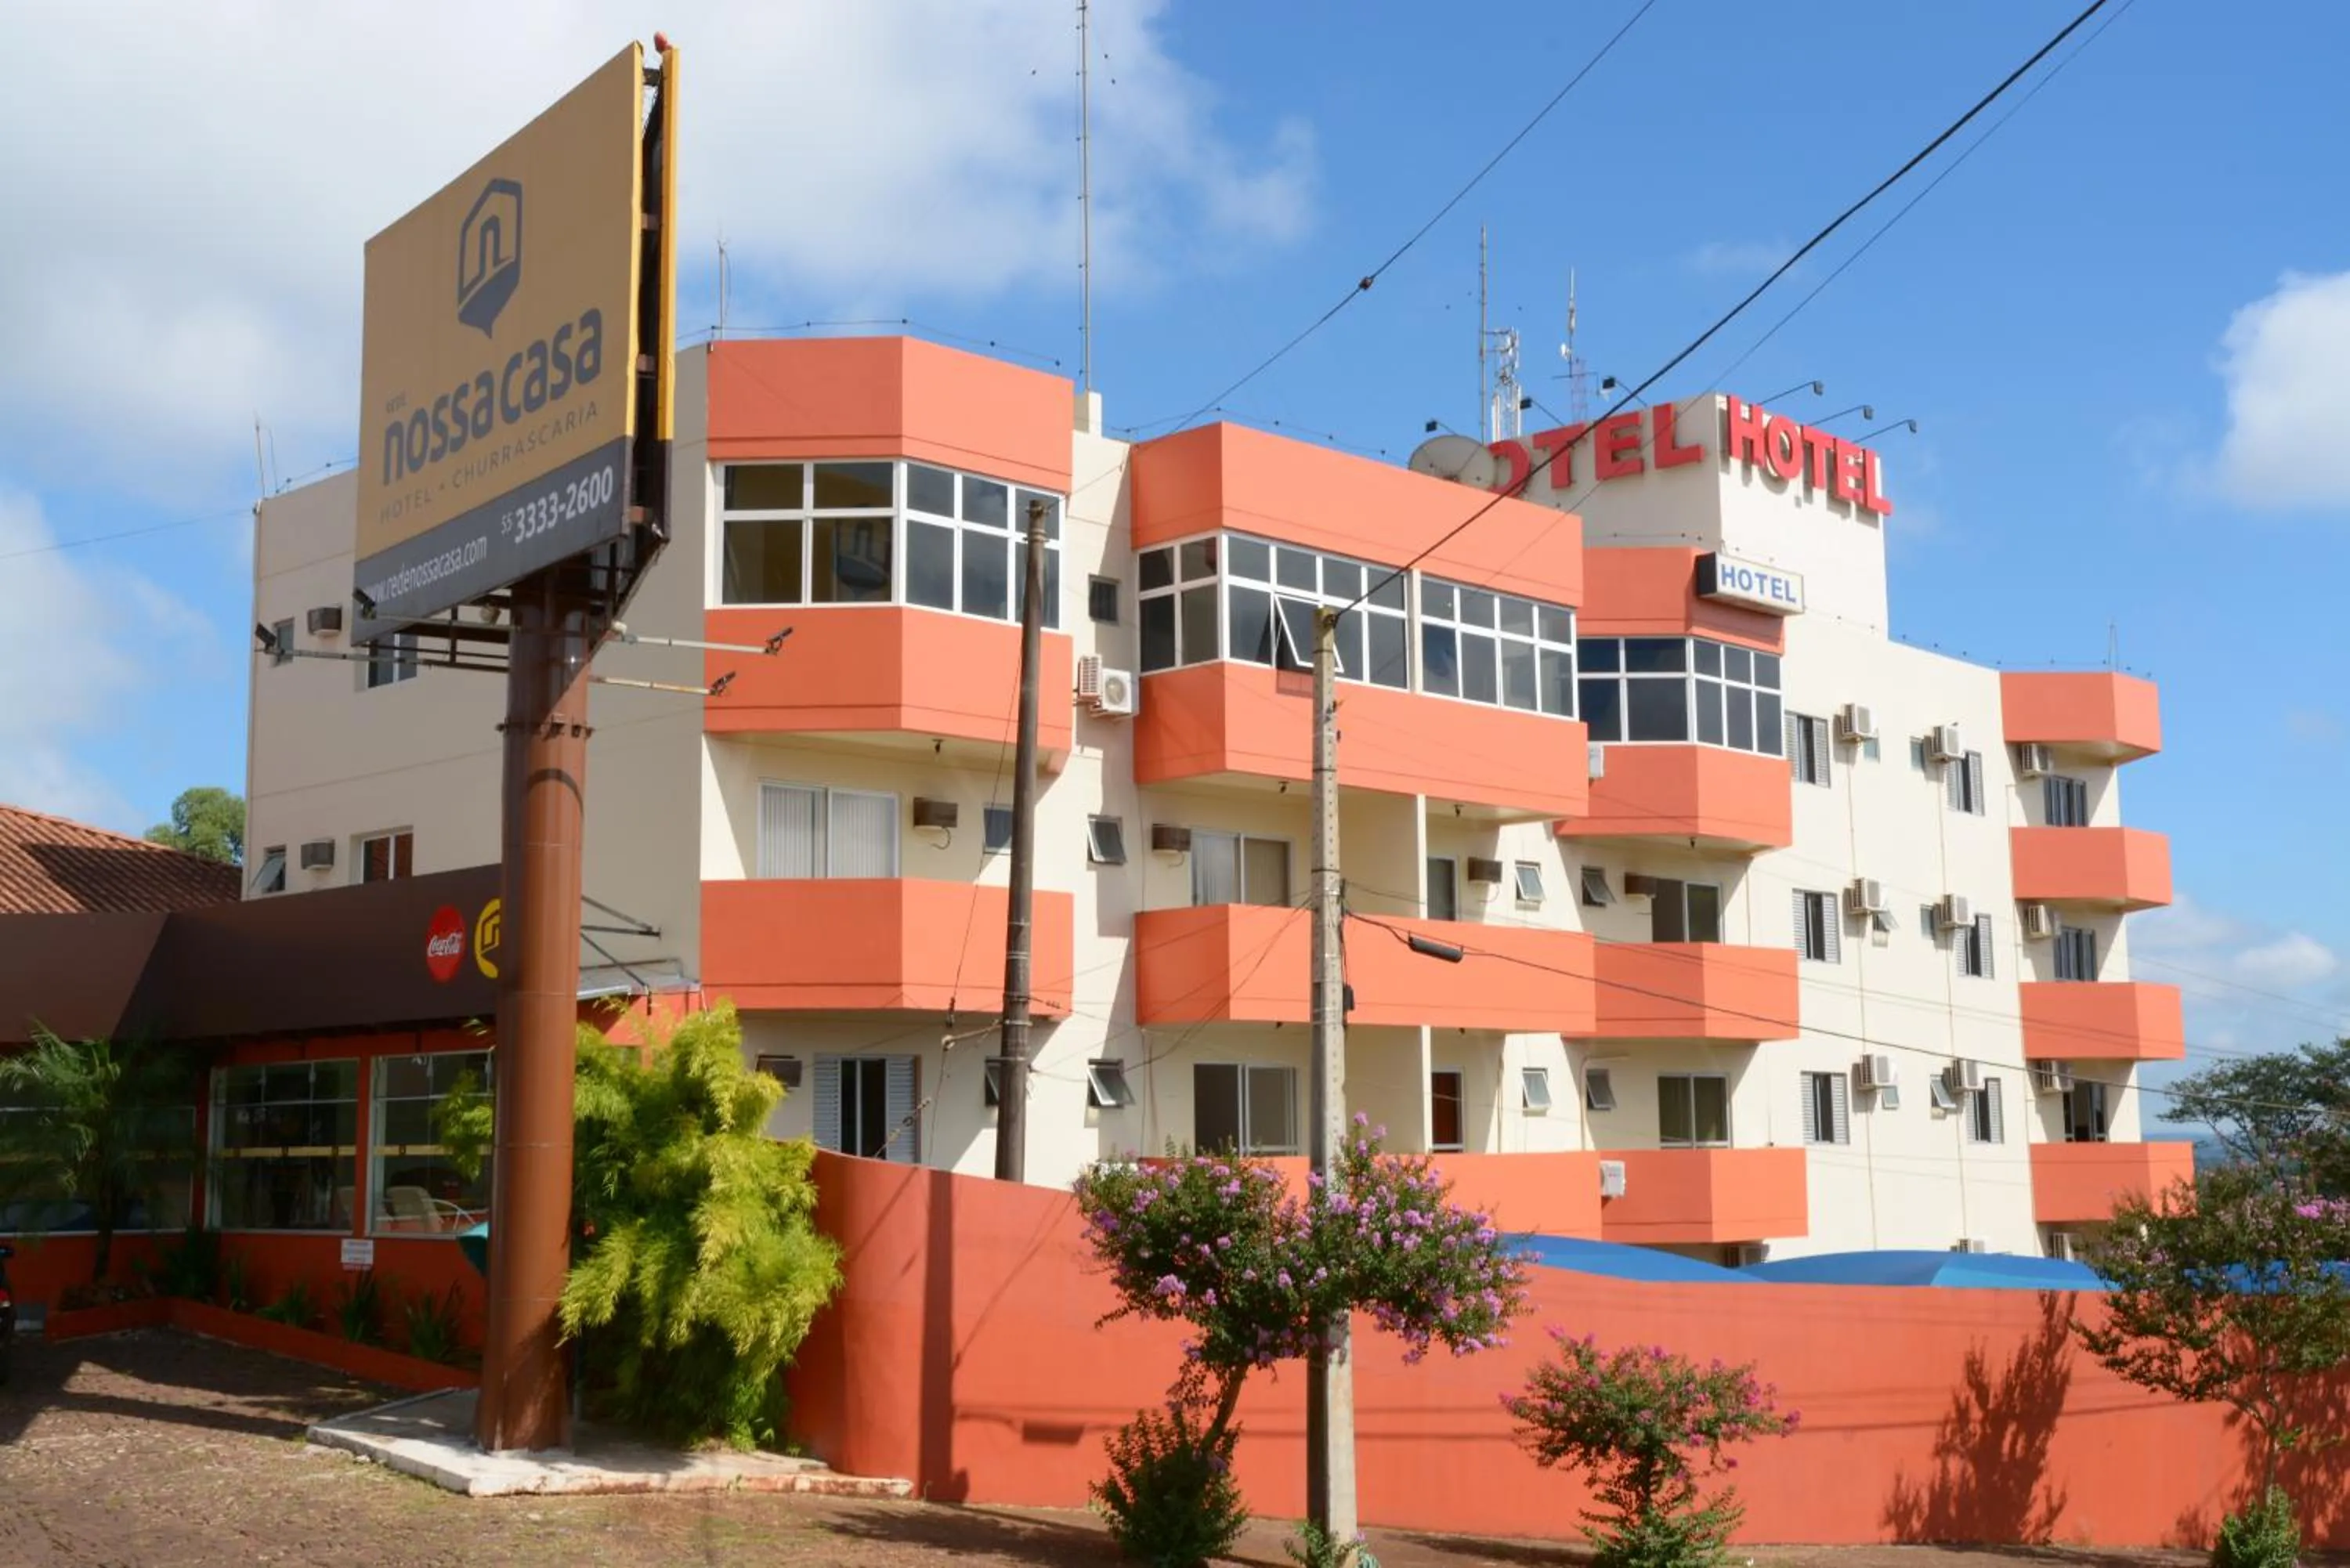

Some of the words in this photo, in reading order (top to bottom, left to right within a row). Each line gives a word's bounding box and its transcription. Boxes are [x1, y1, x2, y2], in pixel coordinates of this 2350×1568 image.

[380, 487, 432, 525] HOTEL
[452, 400, 598, 490] CHURRASCARIA
[1488, 403, 1702, 495] OTEL
[1728, 395, 1891, 515] HOTEL
[514, 465, 613, 544] 3333-2600
[1722, 563, 1797, 604] HOTEL
